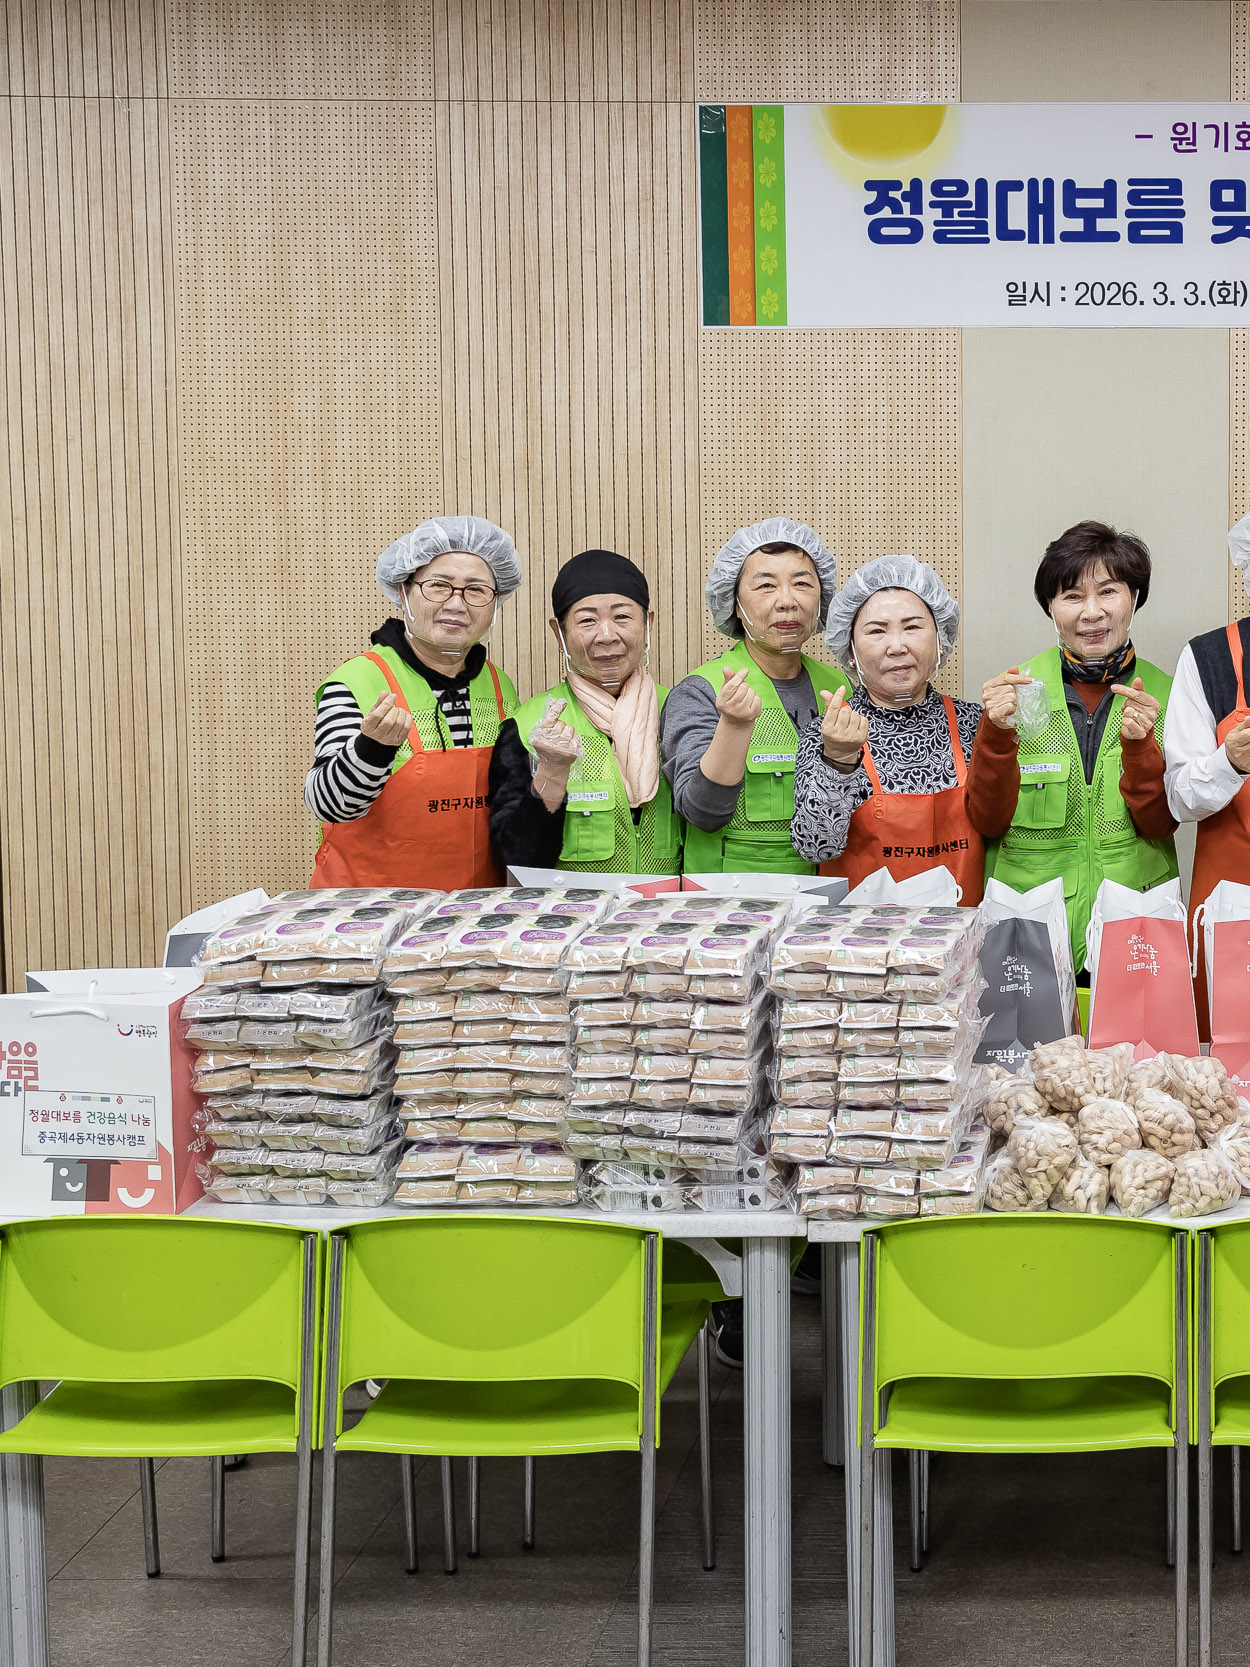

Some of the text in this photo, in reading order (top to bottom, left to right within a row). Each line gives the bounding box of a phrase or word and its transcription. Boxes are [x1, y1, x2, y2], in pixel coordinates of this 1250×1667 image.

[864, 178, 1186, 245] 정월대보름
[1005, 281, 1051, 306] 일시
[1074, 282, 1144, 306] 2026.
[1153, 282, 1175, 306] 3.
[1183, 280, 1248, 308] 3.(화)
[882, 838, 970, 858] 광진구자원봉사센터
[29, 1109, 151, 1127] 정월대보름 건강음식 나눔
[37, 1131, 147, 1147] 중곡제4동자원봉사캠프
